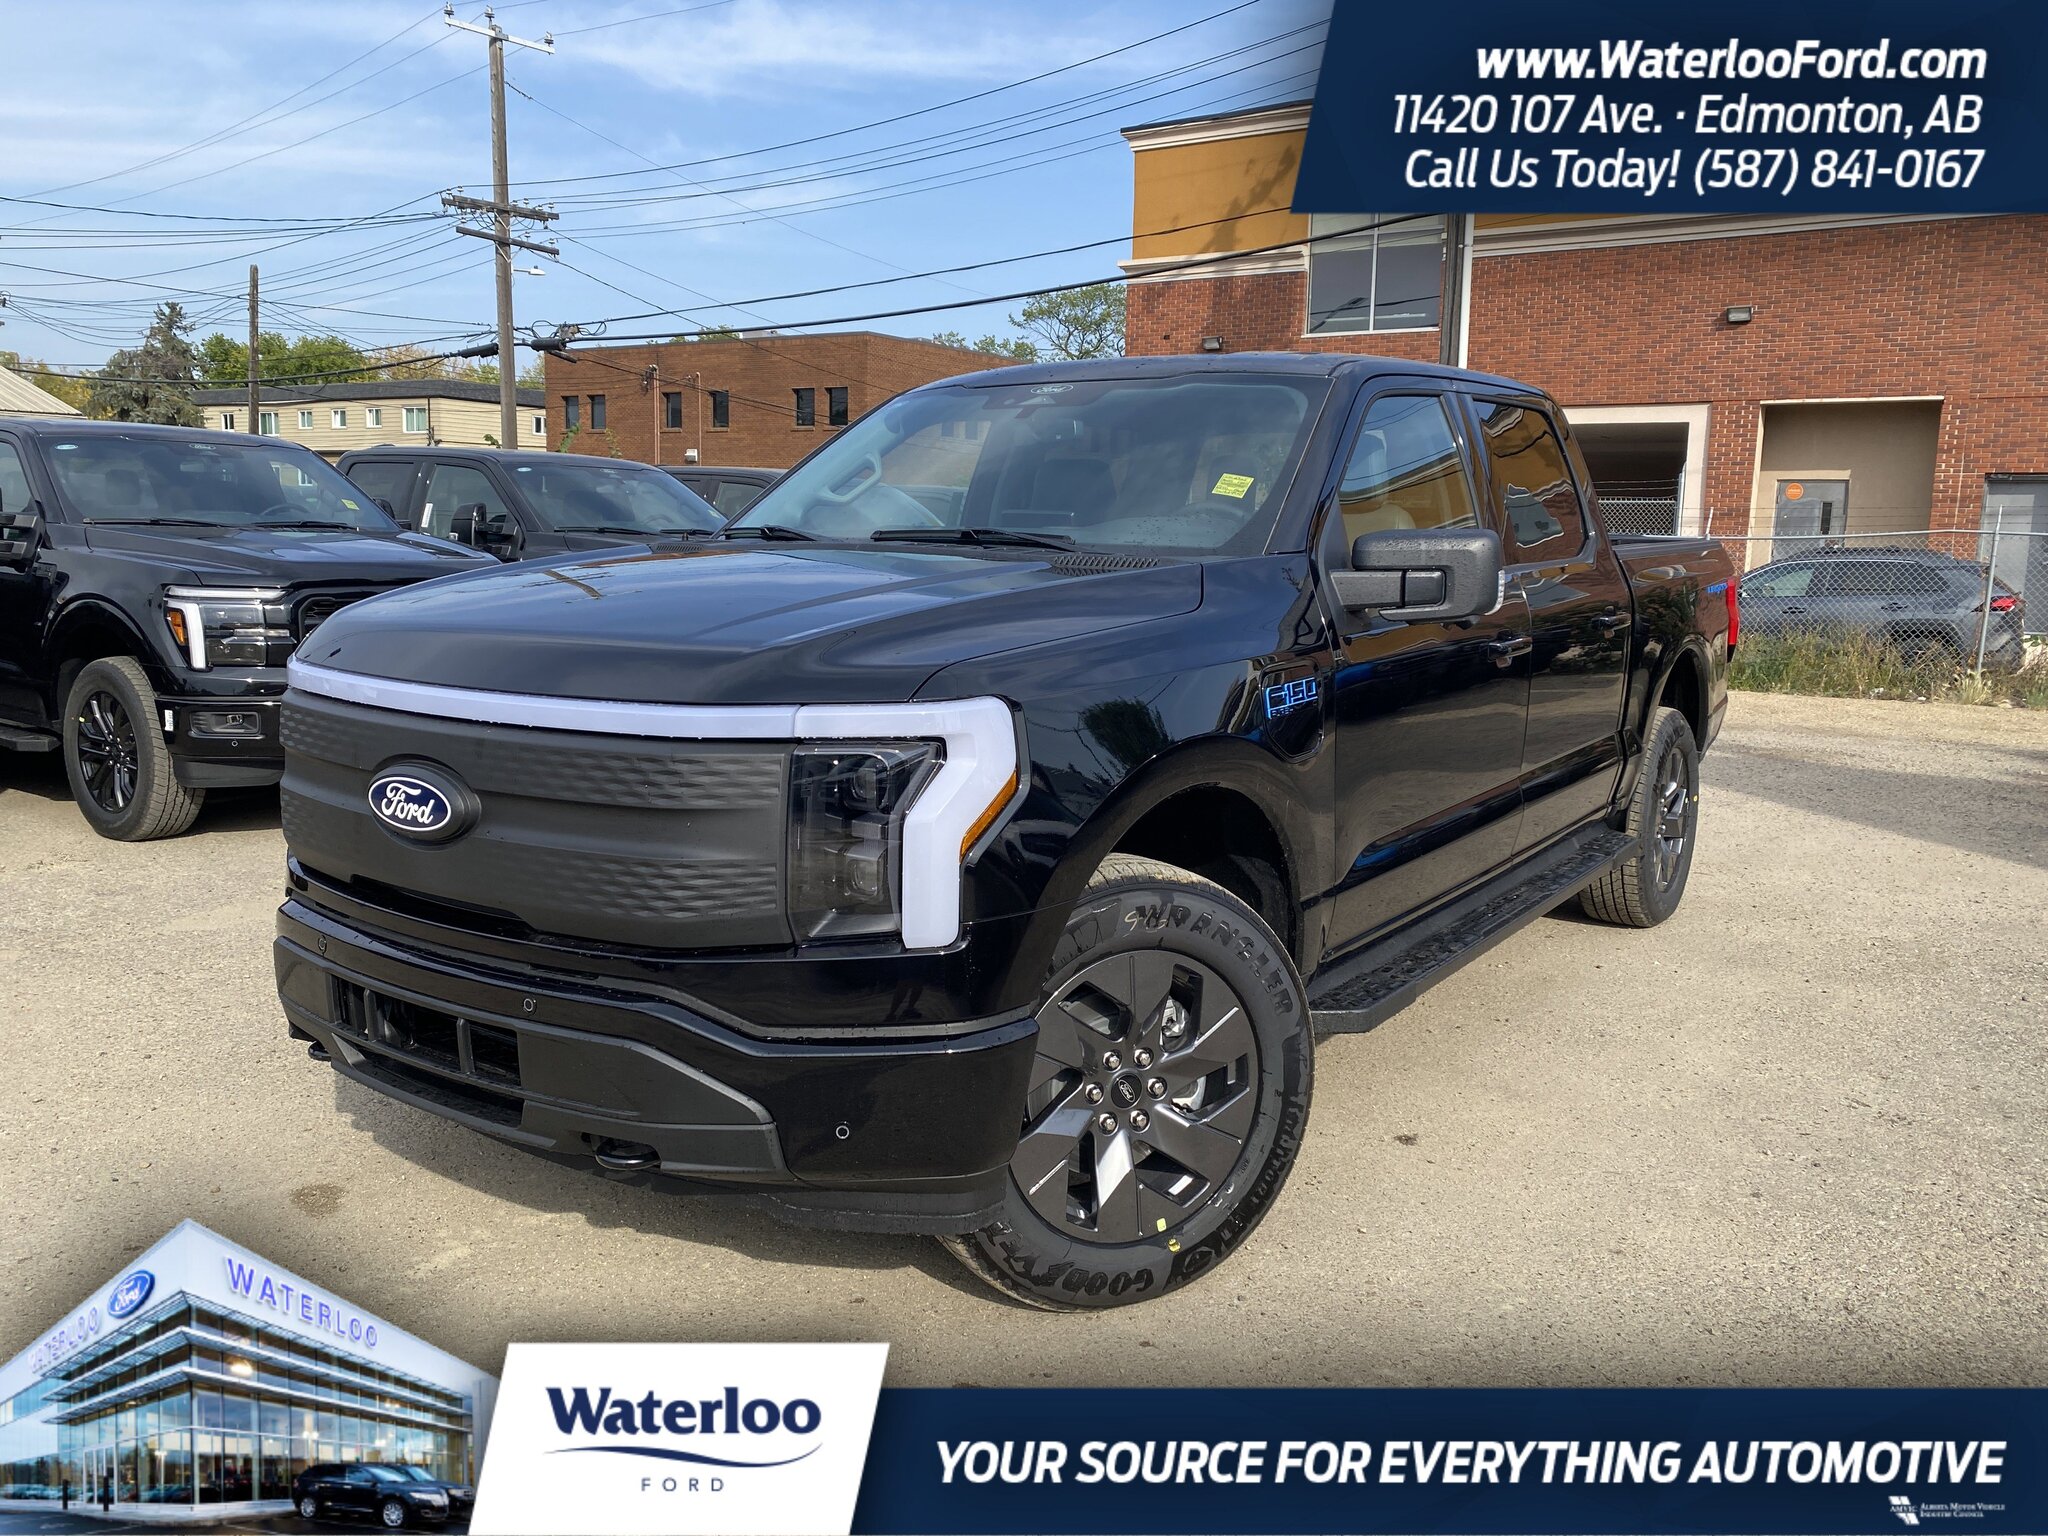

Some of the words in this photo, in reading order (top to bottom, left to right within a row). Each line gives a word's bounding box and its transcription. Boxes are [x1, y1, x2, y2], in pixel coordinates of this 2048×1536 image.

[381, 782, 435, 824] Ford
[1135, 904, 1293, 1017] WRANGLER
[988, 1222, 1154, 1298] GOODYEA
